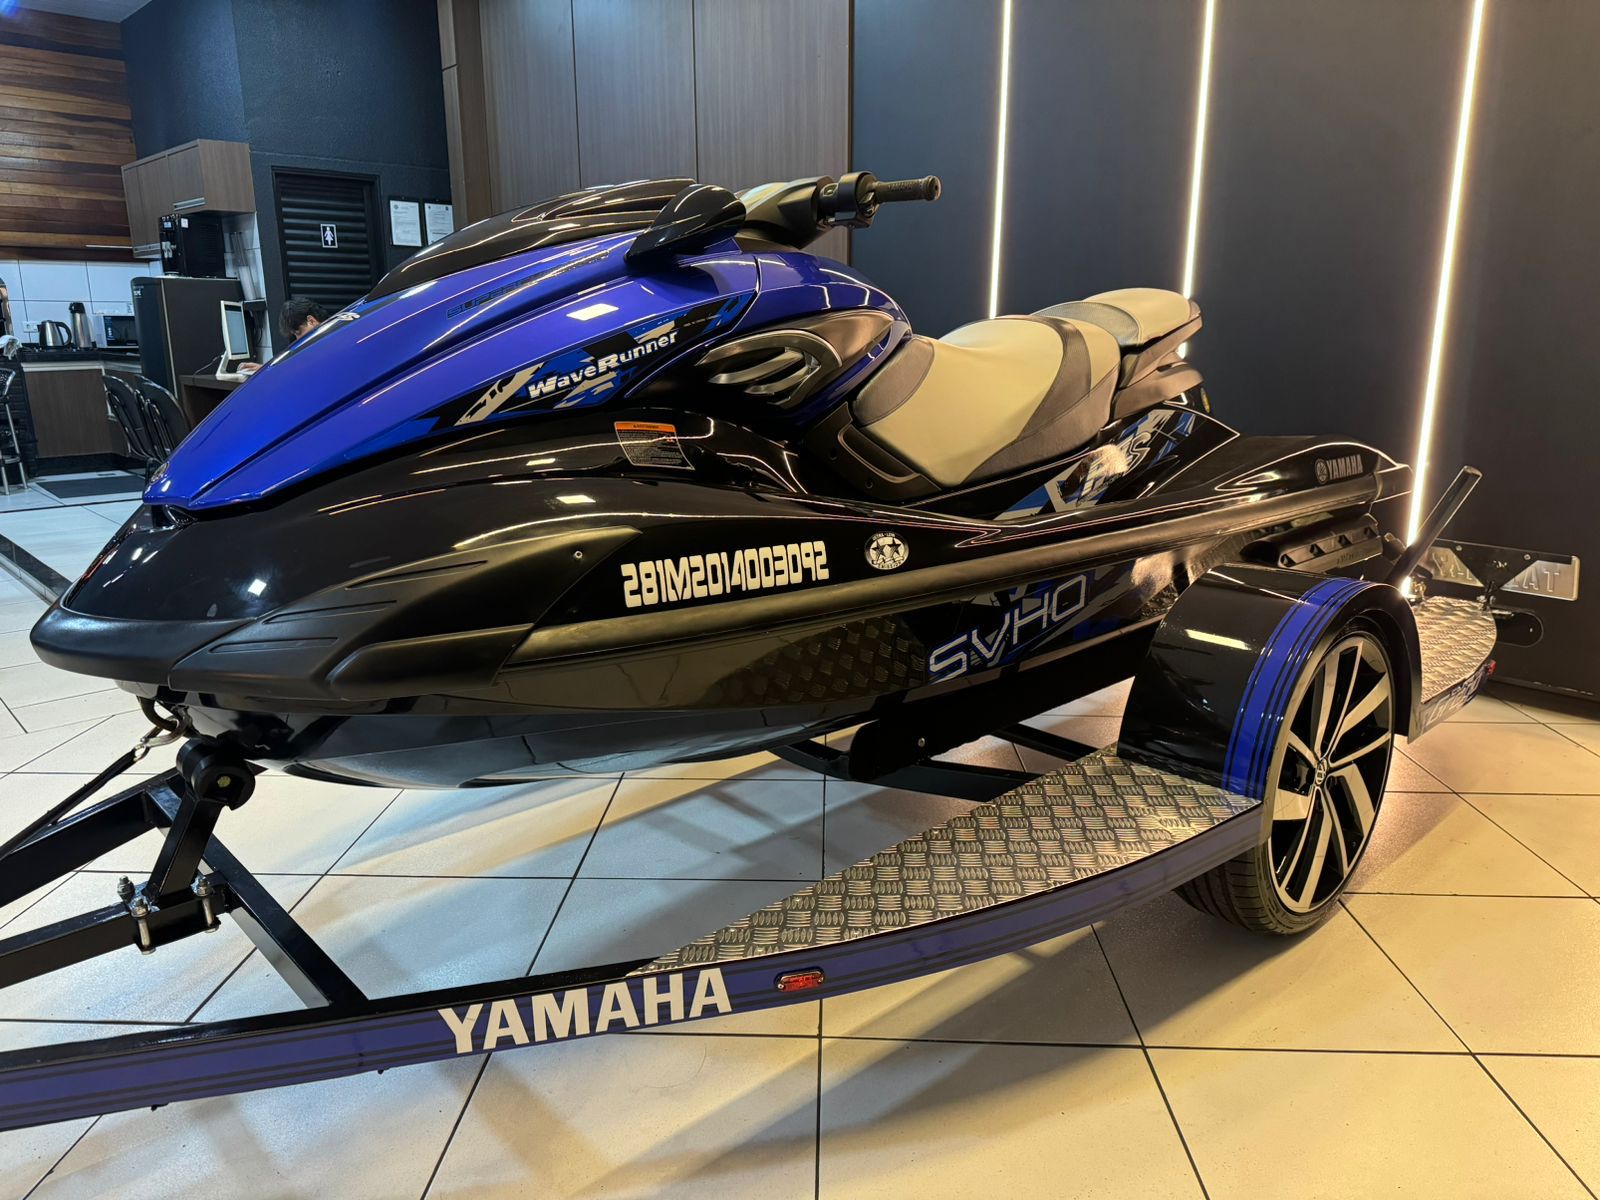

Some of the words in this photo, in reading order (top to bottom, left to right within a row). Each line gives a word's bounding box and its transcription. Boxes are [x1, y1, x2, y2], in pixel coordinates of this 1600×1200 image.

[528, 331, 678, 398] WaveRunner
[1326, 454, 1364, 481] YAMAHA
[620, 540, 830, 609] 281M2014003092
[929, 574, 1087, 685] SVHO
[438, 967, 732, 1055] YAMAHA
